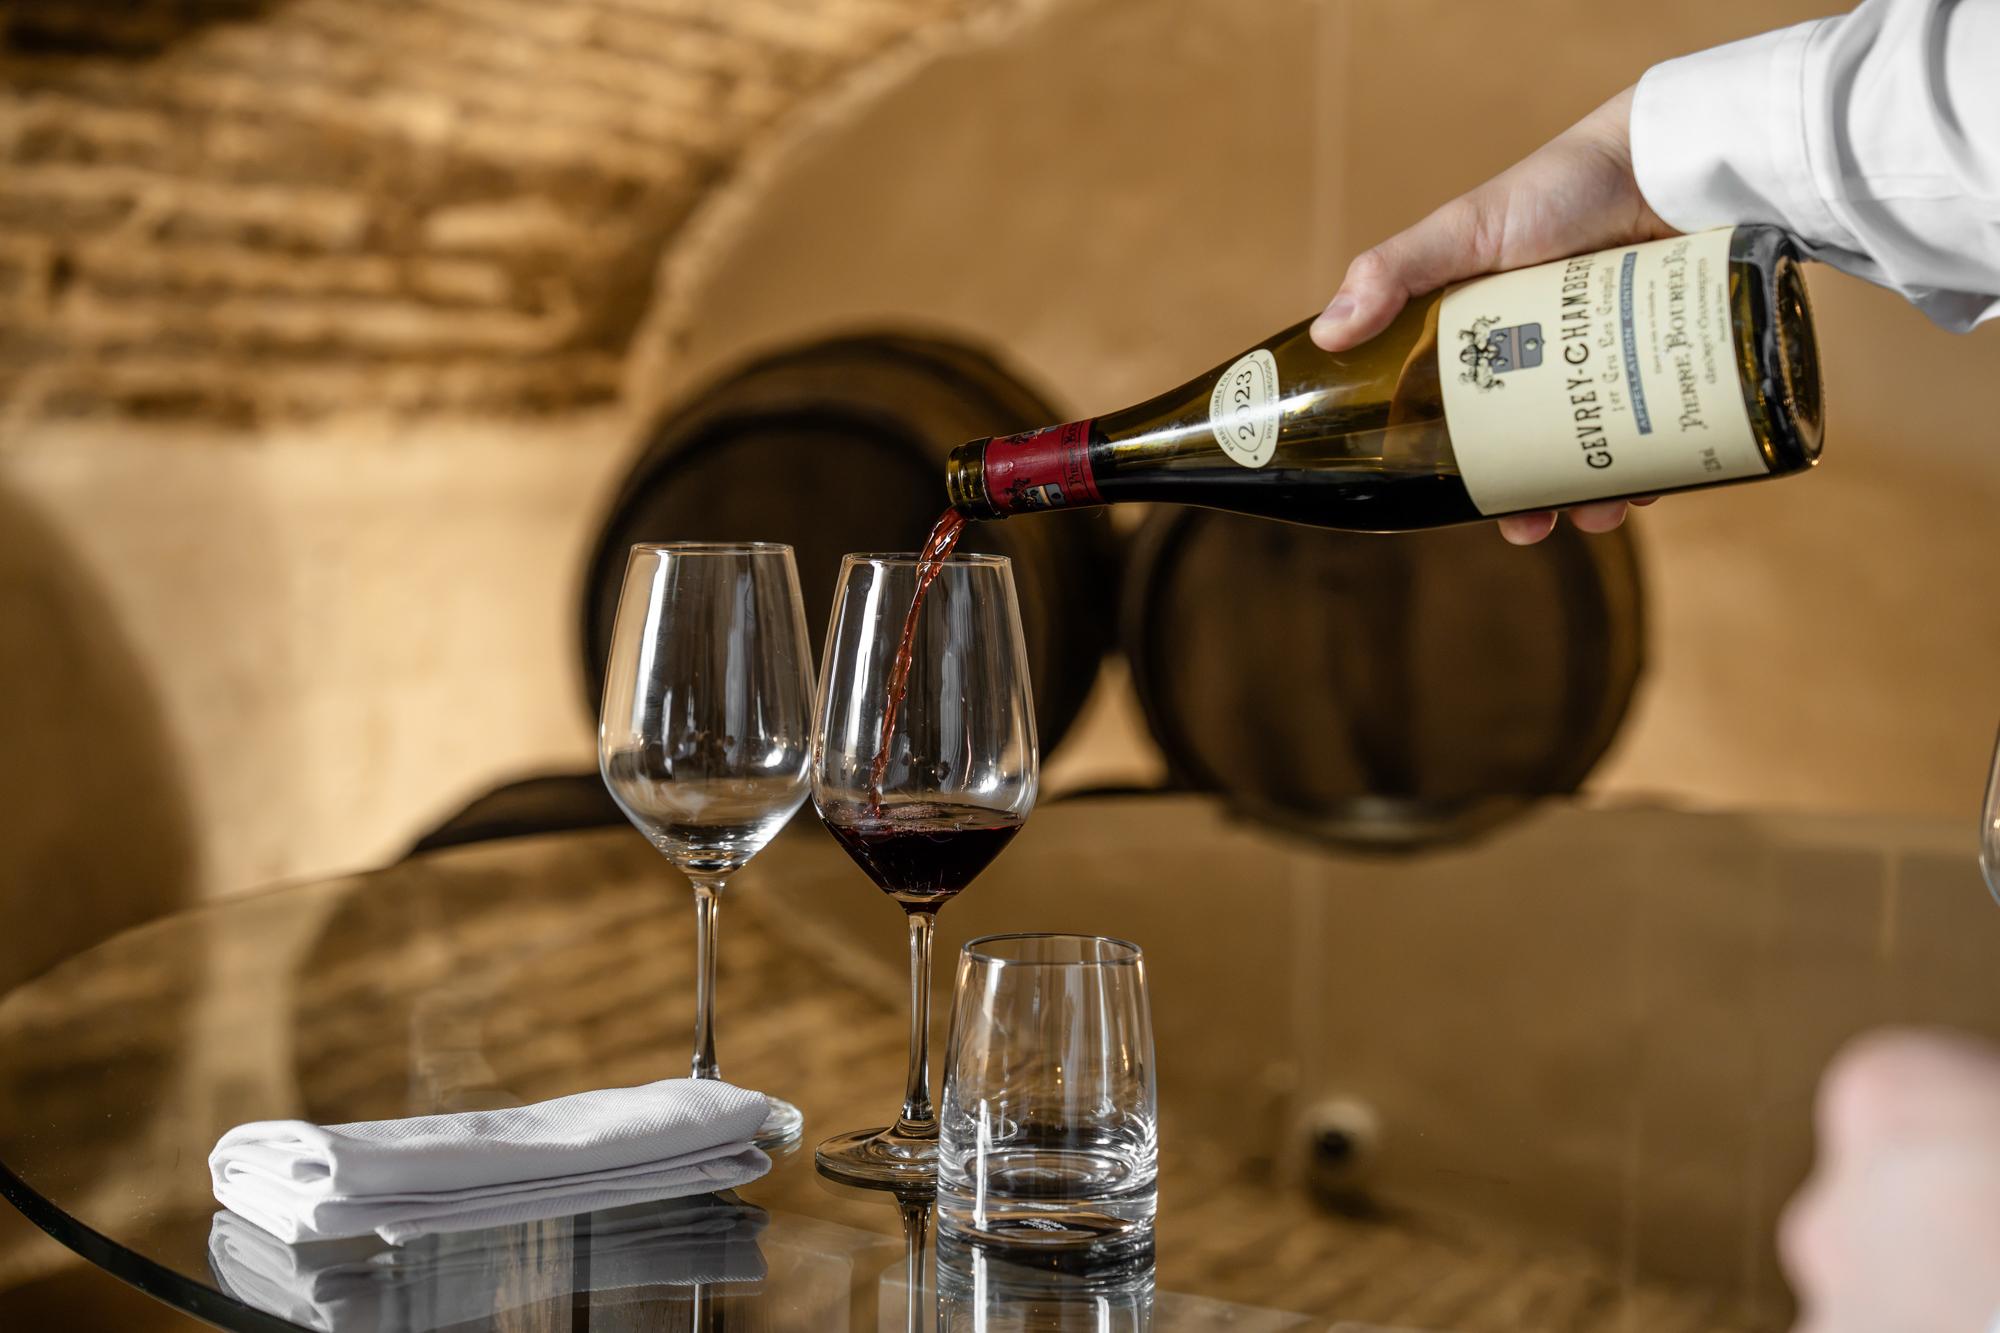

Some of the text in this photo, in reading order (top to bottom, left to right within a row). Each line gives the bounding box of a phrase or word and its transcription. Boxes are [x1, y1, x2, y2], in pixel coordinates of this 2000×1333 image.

[1263, 358, 1275, 405] OURGOGNE
[1560, 255, 1613, 469] GEVREY-CHAMBERT
[1602, 355, 1620, 384] Cru
[1623, 327, 1649, 428] APPELLATION
[1213, 389, 1222, 420] OURÉE
[1234, 370, 1256, 440] 2023
[1675, 353, 1708, 432] PIERRE
[1265, 424, 1274, 440] VIN
